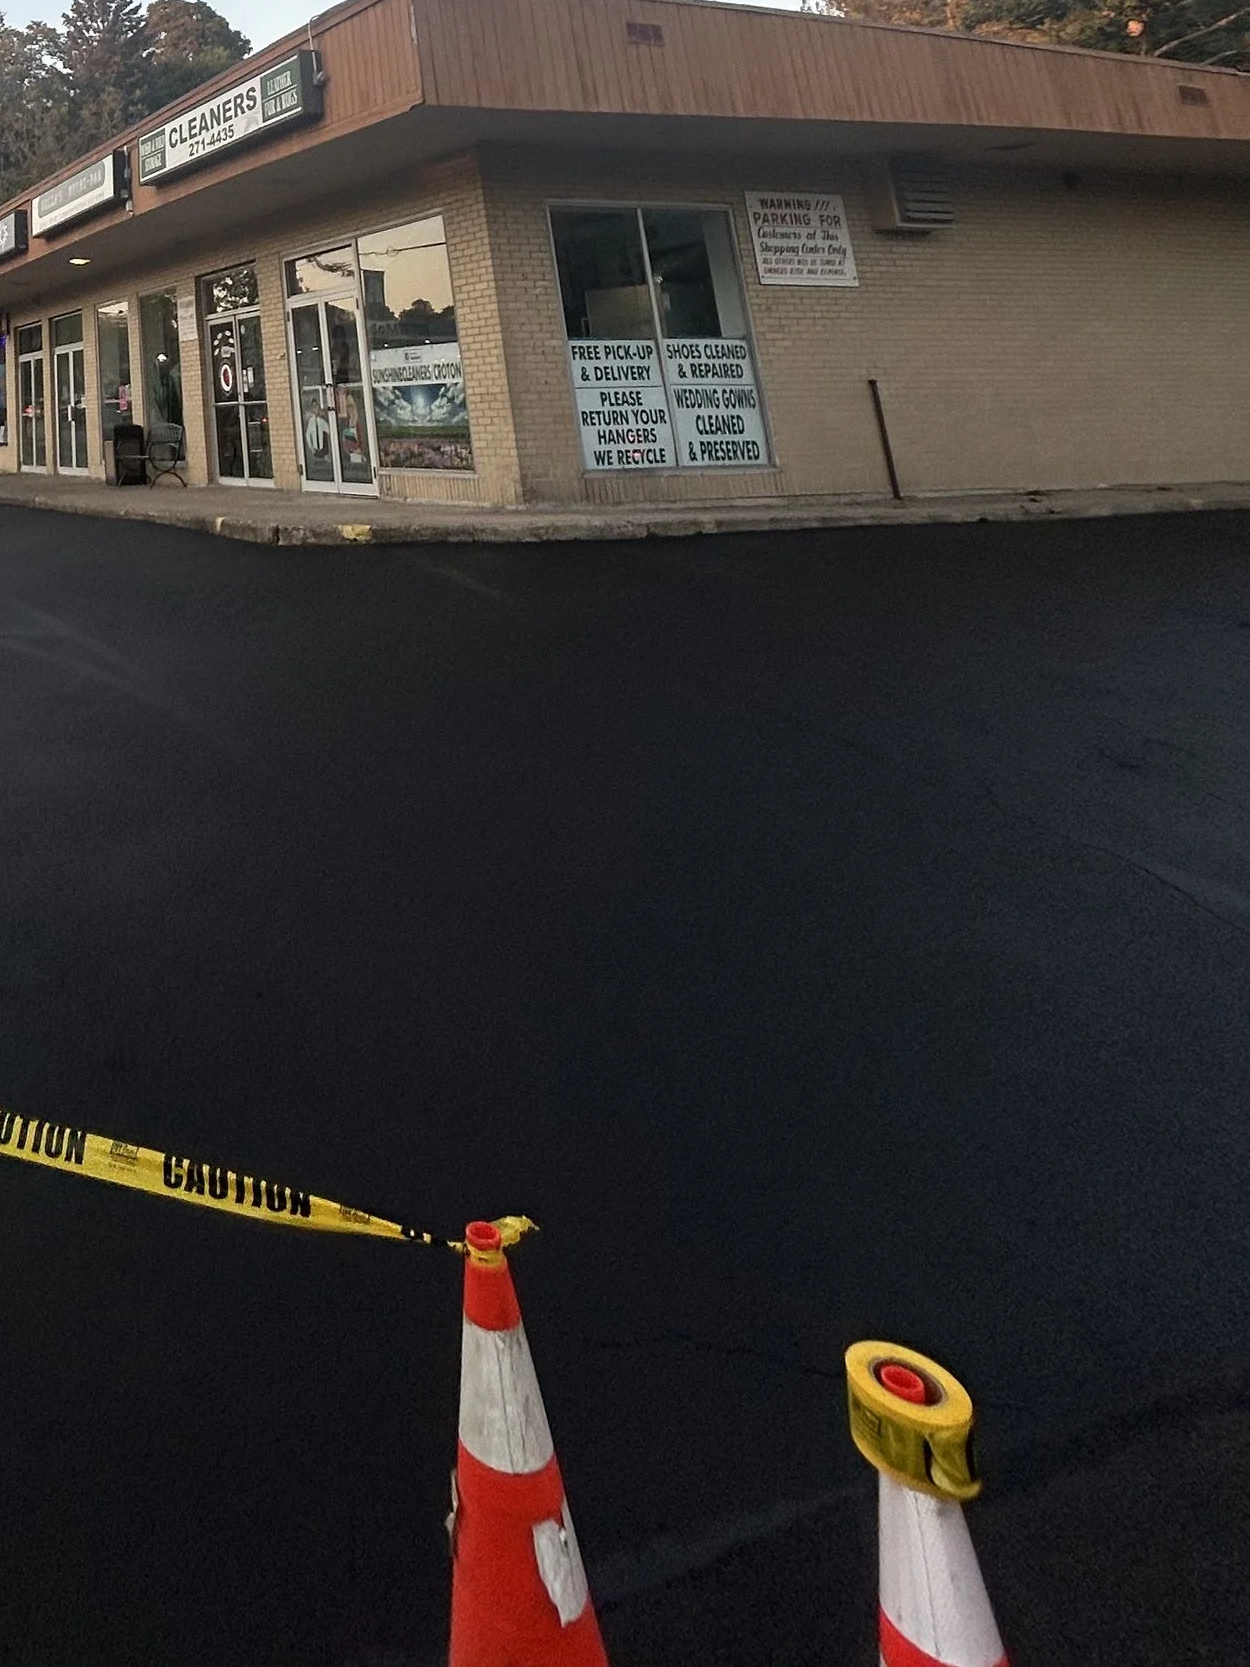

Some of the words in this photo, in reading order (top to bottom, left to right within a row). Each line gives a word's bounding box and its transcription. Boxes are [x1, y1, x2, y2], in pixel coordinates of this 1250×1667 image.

[169, 86, 257, 149] CLEANERS
[188, 125, 234, 157] 271-4435
[759, 198, 811, 211] WARNING
[753, 212, 811, 225] PARKING
[819, 214, 842, 228] FOR
[758, 227, 802, 240] Customers
[821, 230, 839, 241] This
[760, 242, 799, 256] Shopping
[801, 243, 825, 254] Center
[828, 244, 847, 258] Only
[572, 345, 601, 361] FREE
[604, 344, 653, 360] PICK-UP
[666, 343, 701, 360] SHOES
[704, 344, 746, 360] CLEANED
[433, 362, 462, 380] CROTON
[581, 368, 590, 382] &
[595, 365, 651, 381] DELIVERY
[678, 364, 687, 379] &
[691, 364, 744, 379] REPAIRED
[600, 391, 643, 407] PLEASE
[673, 388, 720, 409] WEDDING
[722, 389, 757, 409] GOWNS
[581, 410, 629, 427] RETURN
[633, 409, 667, 425] YOUR
[696, 414, 745, 435] CLEANED
[598, 428, 657, 445] HANGERS
[594, 450, 613, 466] WE
[618, 448, 666, 465] RECYCLE
[688, 442, 697, 461] &
[700, 440, 760, 461] PRESERVED
[162, 1152, 311, 1218] CAUTION
